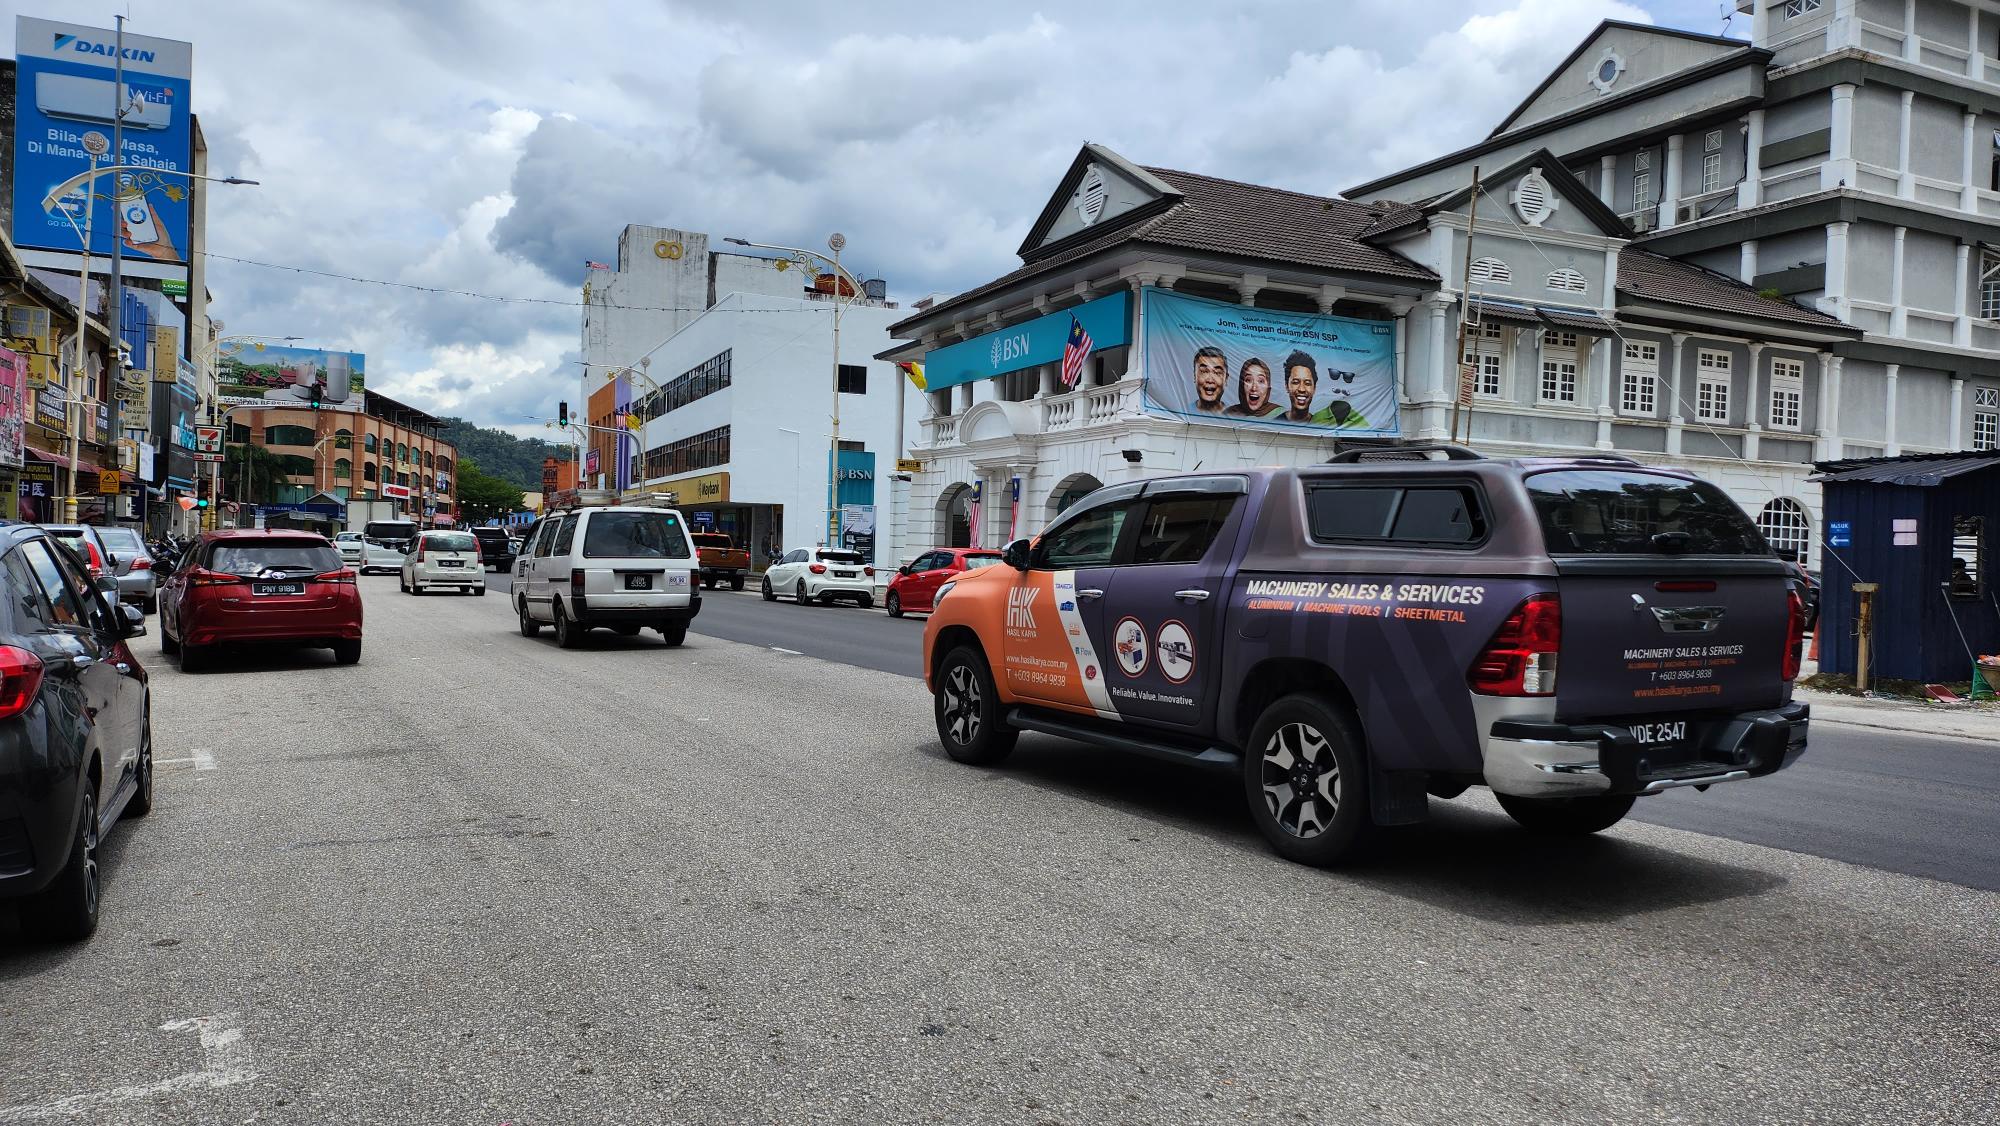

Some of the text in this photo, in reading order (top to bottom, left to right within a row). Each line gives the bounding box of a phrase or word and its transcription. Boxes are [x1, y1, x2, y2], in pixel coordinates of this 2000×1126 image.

[75, 40, 155, 63] DAIKIN
[130, 87, 168, 104] Wi-Fi
[28, 141, 42, 153] Di
[130, 154, 177, 171] Sahaja
[119, 139, 159, 155] Masa,
[1217, 318, 1338, 343] Jom, simpan dalam BSN SSP
[1003, 332, 1030, 361] BSN
[848, 469, 873, 480] BSN
[18, 481, 45, 498] 中医
[702, 480, 720, 498] Maybank
[1246, 580, 1485, 605] MACHINERY SALES & SERVICES
[1007, 587, 1040, 628] HK
[1247, 600, 1467, 622] ALUMINIUM MACHINE TOOLS SHEETMETAL
[1006, 628, 1037, 639] HASIL KARYA
[1623, 644, 1743, 660] MACHINERY SALES & SERVICES
[1006, 655, 1068, 670] www.hasilkarya.com.my
[1006, 668, 1066, 687] T +603 8964 9838
[1650, 669, 1712, 681] T +603 8964 9838
[1629, 721, 1686, 744] VDE 2547
